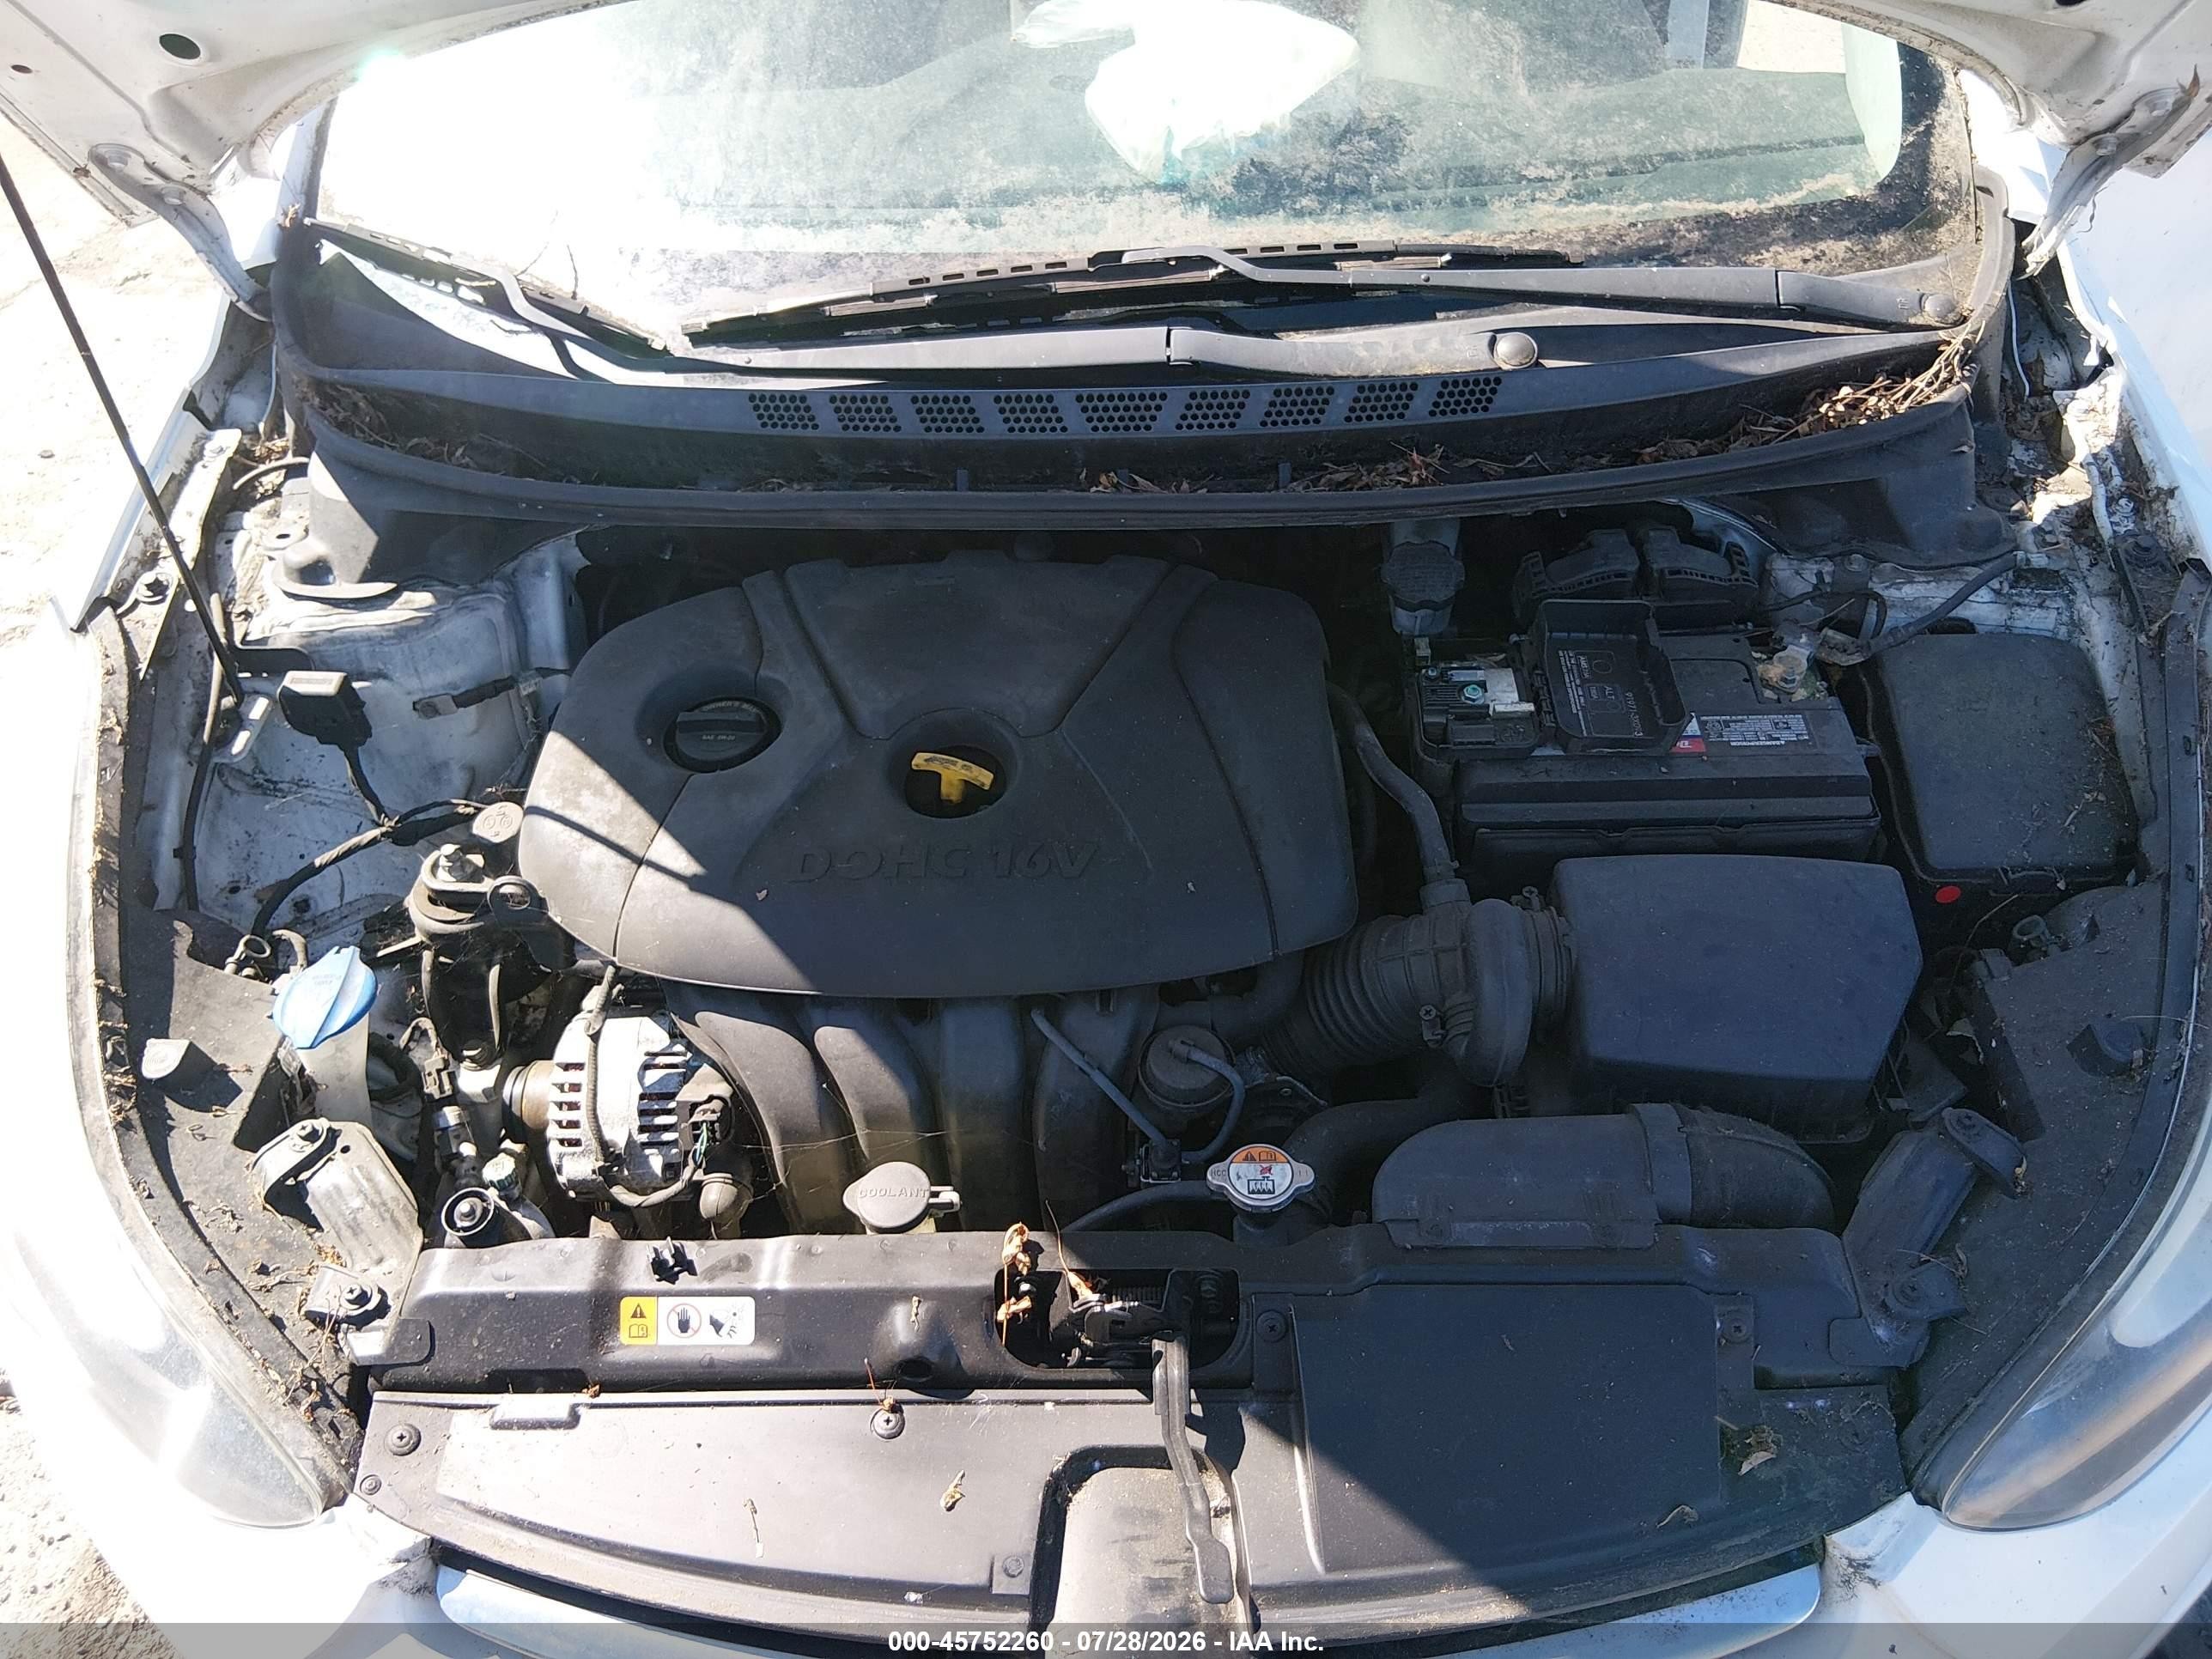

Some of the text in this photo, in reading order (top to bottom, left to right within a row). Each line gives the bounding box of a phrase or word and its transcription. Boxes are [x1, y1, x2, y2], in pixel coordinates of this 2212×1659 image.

[787, 842, 1100, 883] DOHC 16V
[859, 1186, 930, 1198] COOLANT
